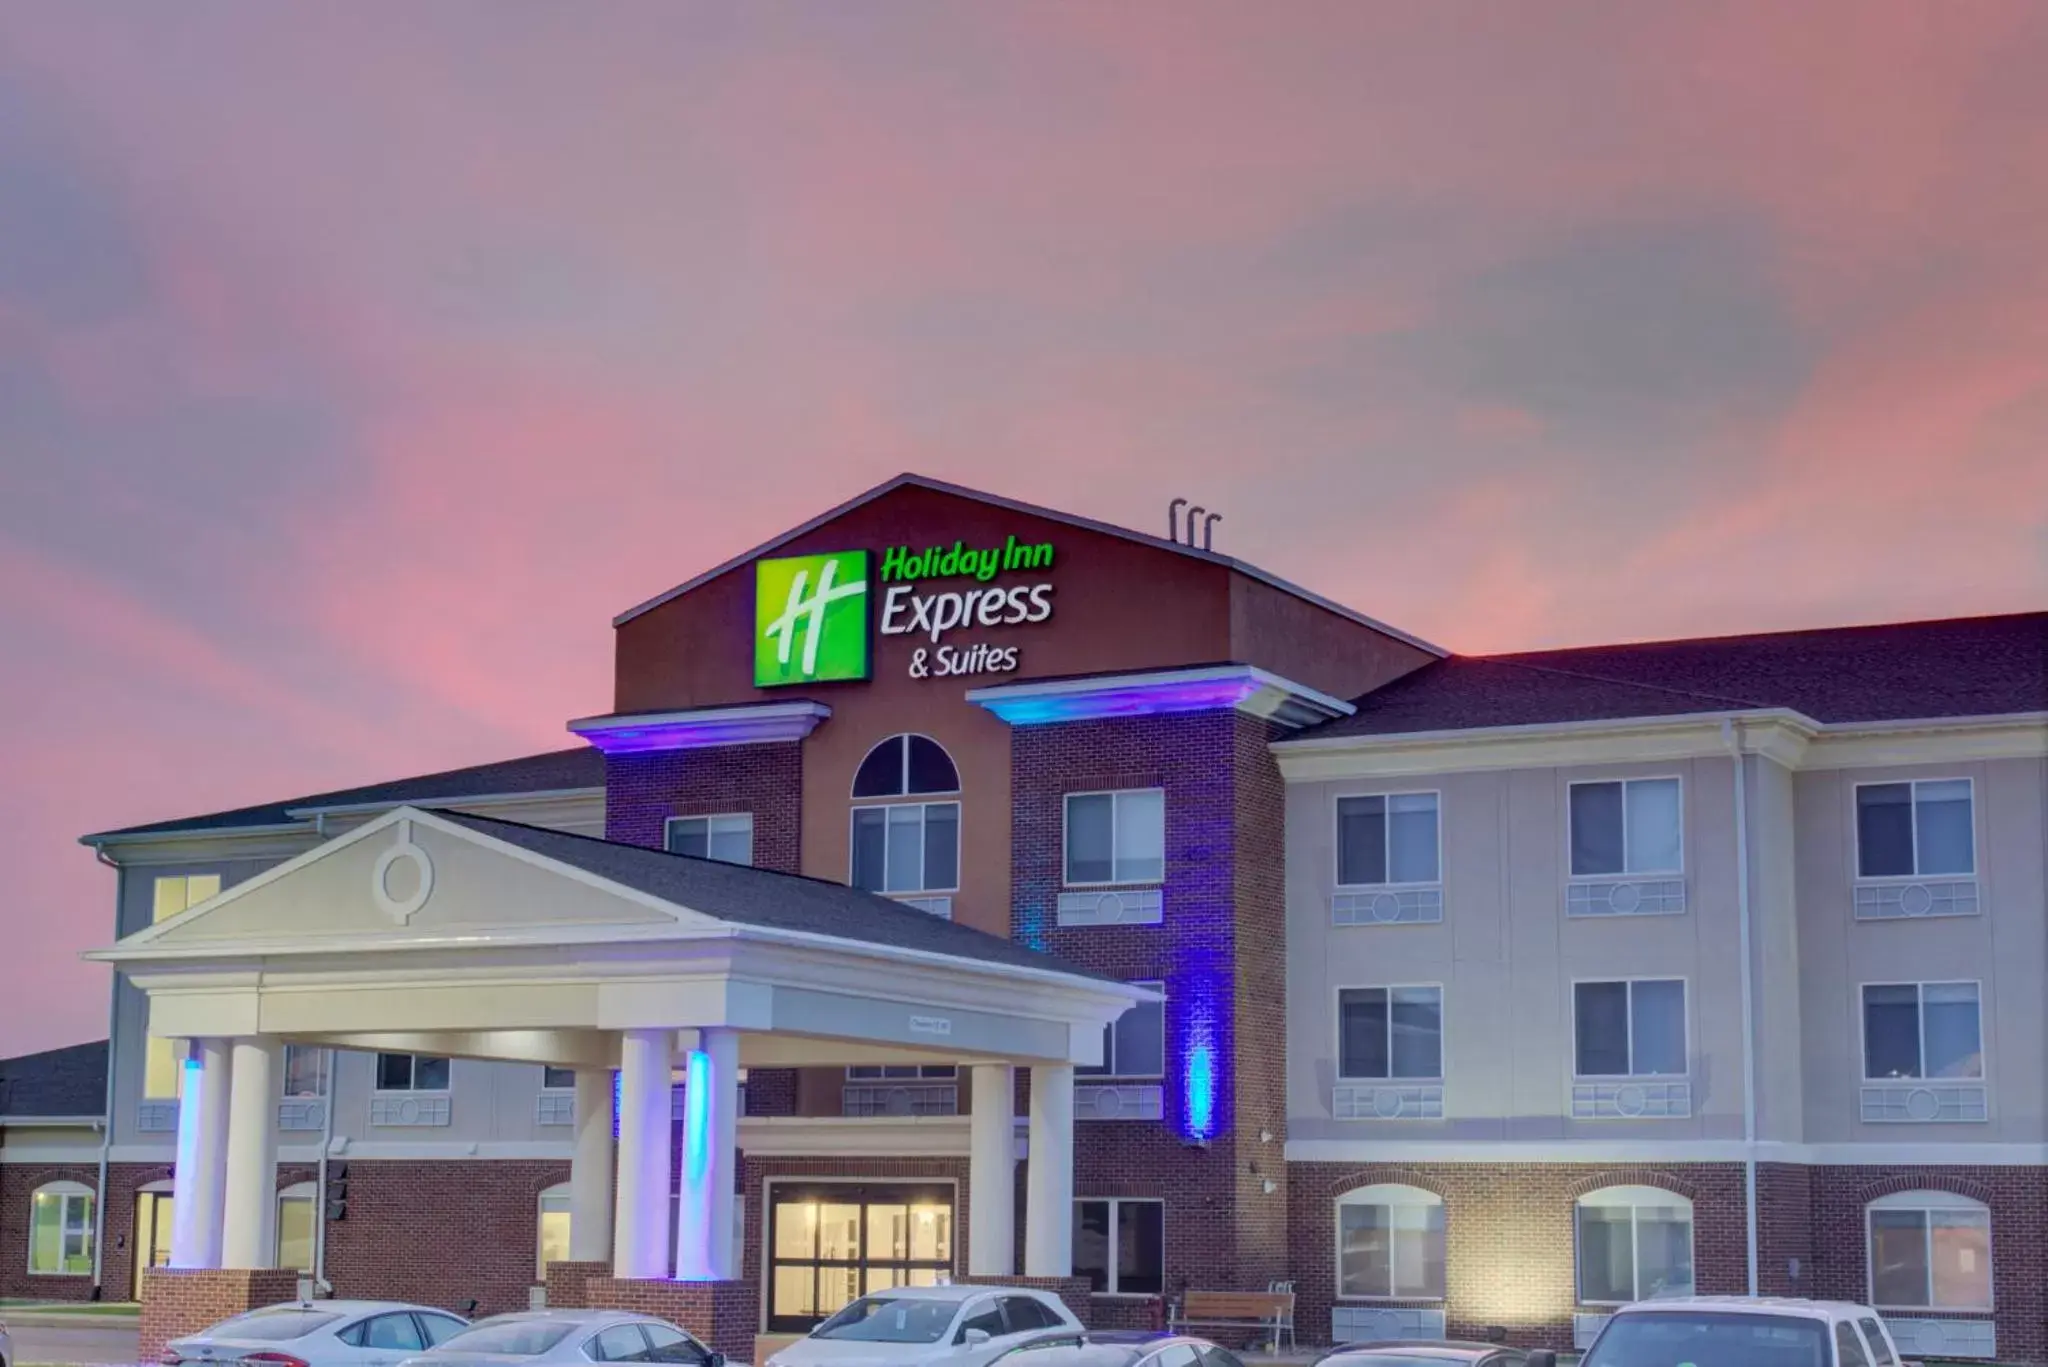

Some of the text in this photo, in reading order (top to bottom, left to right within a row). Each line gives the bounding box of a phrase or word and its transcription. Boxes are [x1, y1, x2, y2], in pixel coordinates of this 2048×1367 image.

[881, 535, 1054, 582] Holiday Inn
[881, 584, 1053, 643] Express
[909, 644, 1018, 678] & Suites
